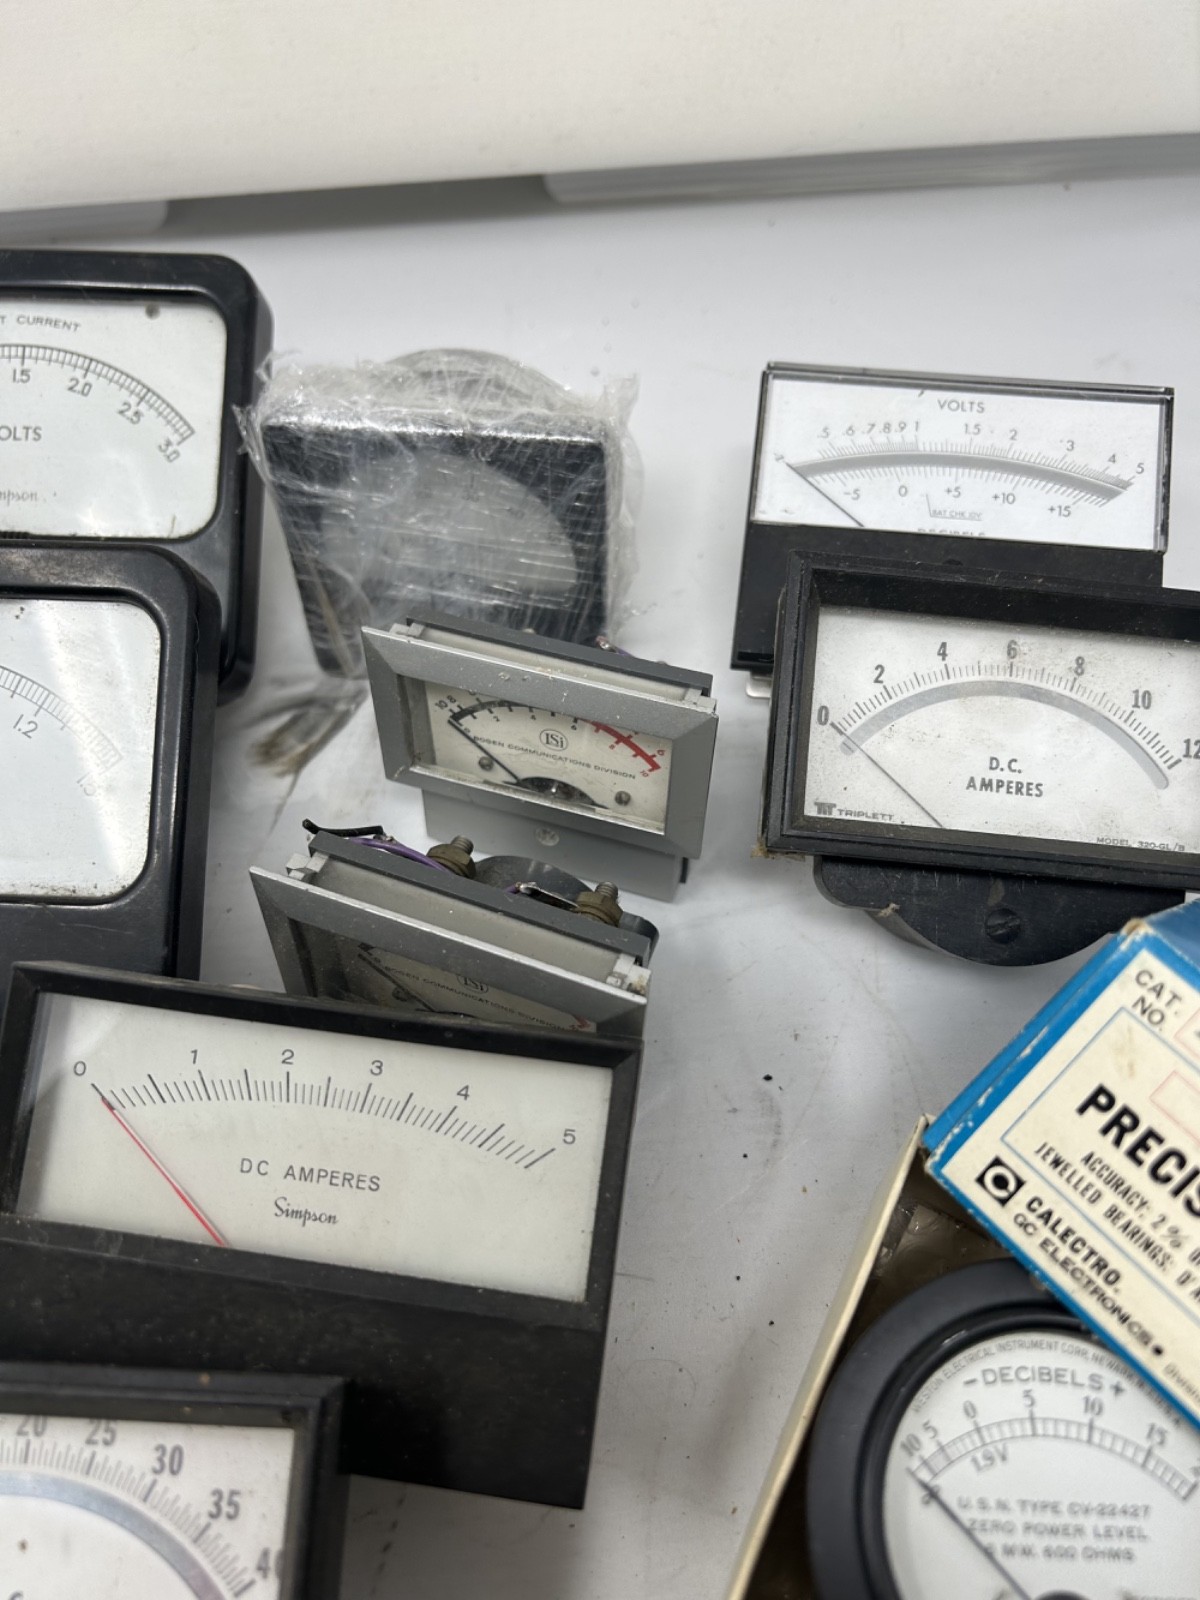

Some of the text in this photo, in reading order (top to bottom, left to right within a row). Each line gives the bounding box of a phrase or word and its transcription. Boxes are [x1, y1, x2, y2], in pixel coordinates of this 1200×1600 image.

[16, 313, 82, 332] CURRENT
[12, 368, 31, 383] 1.5
[67, 377, 93, 397] 2.0
[117, 402, 145, 425] 2.5
[937, 399, 985, 415] VOLTS
[914, 421, 920, 433] 1
[963, 422, 982, 436] 1.5
[1008, 428, 1019, 441] 2
[158, 438, 181, 463] 3.0
[1065, 440, 1076, 453] 3
[1107, 453, 1117, 465] 4
[1135, 463, 1145, 475] 5
[898, 484, 908, 498] 0
[992, 491, 1016, 505] +10
[1047, 504, 1072, 519] +15
[937, 641, 948, 661] 4
[1007, 639, 1018, 659] 6
[873, 664, 885, 684] 2
[1074, 656, 1086, 677] 8
[1132, 689, 1152, 710] 10
[817, 705, 830, 726] 0
[12, 714, 39, 740] 1.2
[966, 777, 1044, 798] AMPERES
[837, 808, 895, 821] TRIPLETT
[190, 1049, 199, 1065] 1
[281, 1049, 295, 1066] 2
[73, 1061, 87, 1077] 0
[370, 1060, 384, 1076] 3
[456, 1084, 470, 1101] 4
[563, 1129, 577, 1146] 5
[240, 1157, 382, 1193] DC AMPERES
[1034, 1142, 1102, 1205] JEWELLED
[274, 1197, 339, 1227] Simpson
[1013, 1212, 1154, 1346] GC ELECTRONICS
[995, 1340, 1059, 1352] INSTRUMENT
[1022, 1390, 1036, 1408] 5
[1083, 1395, 1104, 1418] 10
[85, 1418, 118, 1447] 25
[1147, 1422, 1169, 1447] 15
[151, 1444, 185, 1476] 30
[208, 1488, 242, 1521] 35
[1017, 1498, 1063, 1516] TYPE
